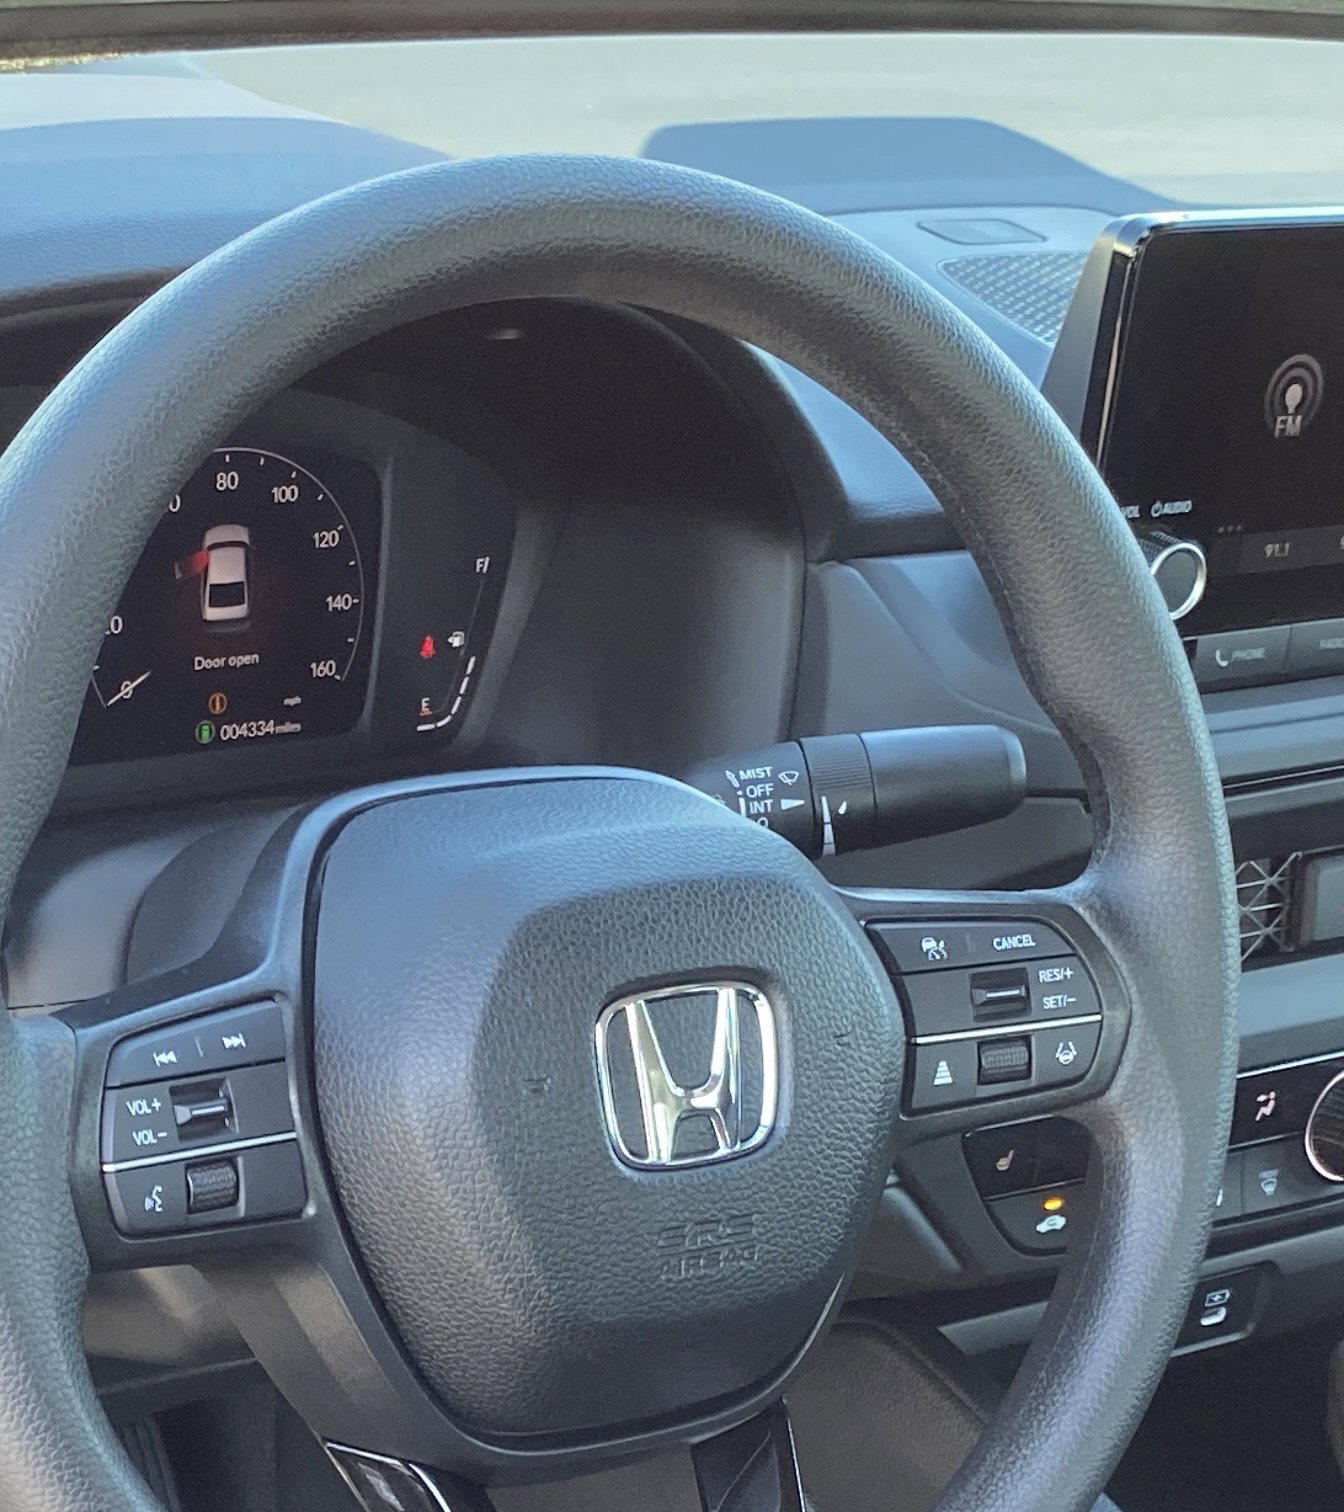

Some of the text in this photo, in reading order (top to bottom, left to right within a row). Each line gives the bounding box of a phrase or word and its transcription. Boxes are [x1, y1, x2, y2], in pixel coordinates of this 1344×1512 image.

[1274, 415, 1303, 440] FM
[216, 471, 239, 491] 80
[271, 484, 299, 504] 100
[313, 530, 340, 549] 120
[326, 593, 353, 612] 140
[194, 653, 260, 671] Door open
[310, 660, 337, 678] 160
[220, 719, 274, 741] 004334
[739, 766, 773, 780] MIST
[746, 783, 775, 798] OFF
[749, 799, 774, 814] INT
[993, 933, 1036, 951] CANCEL
